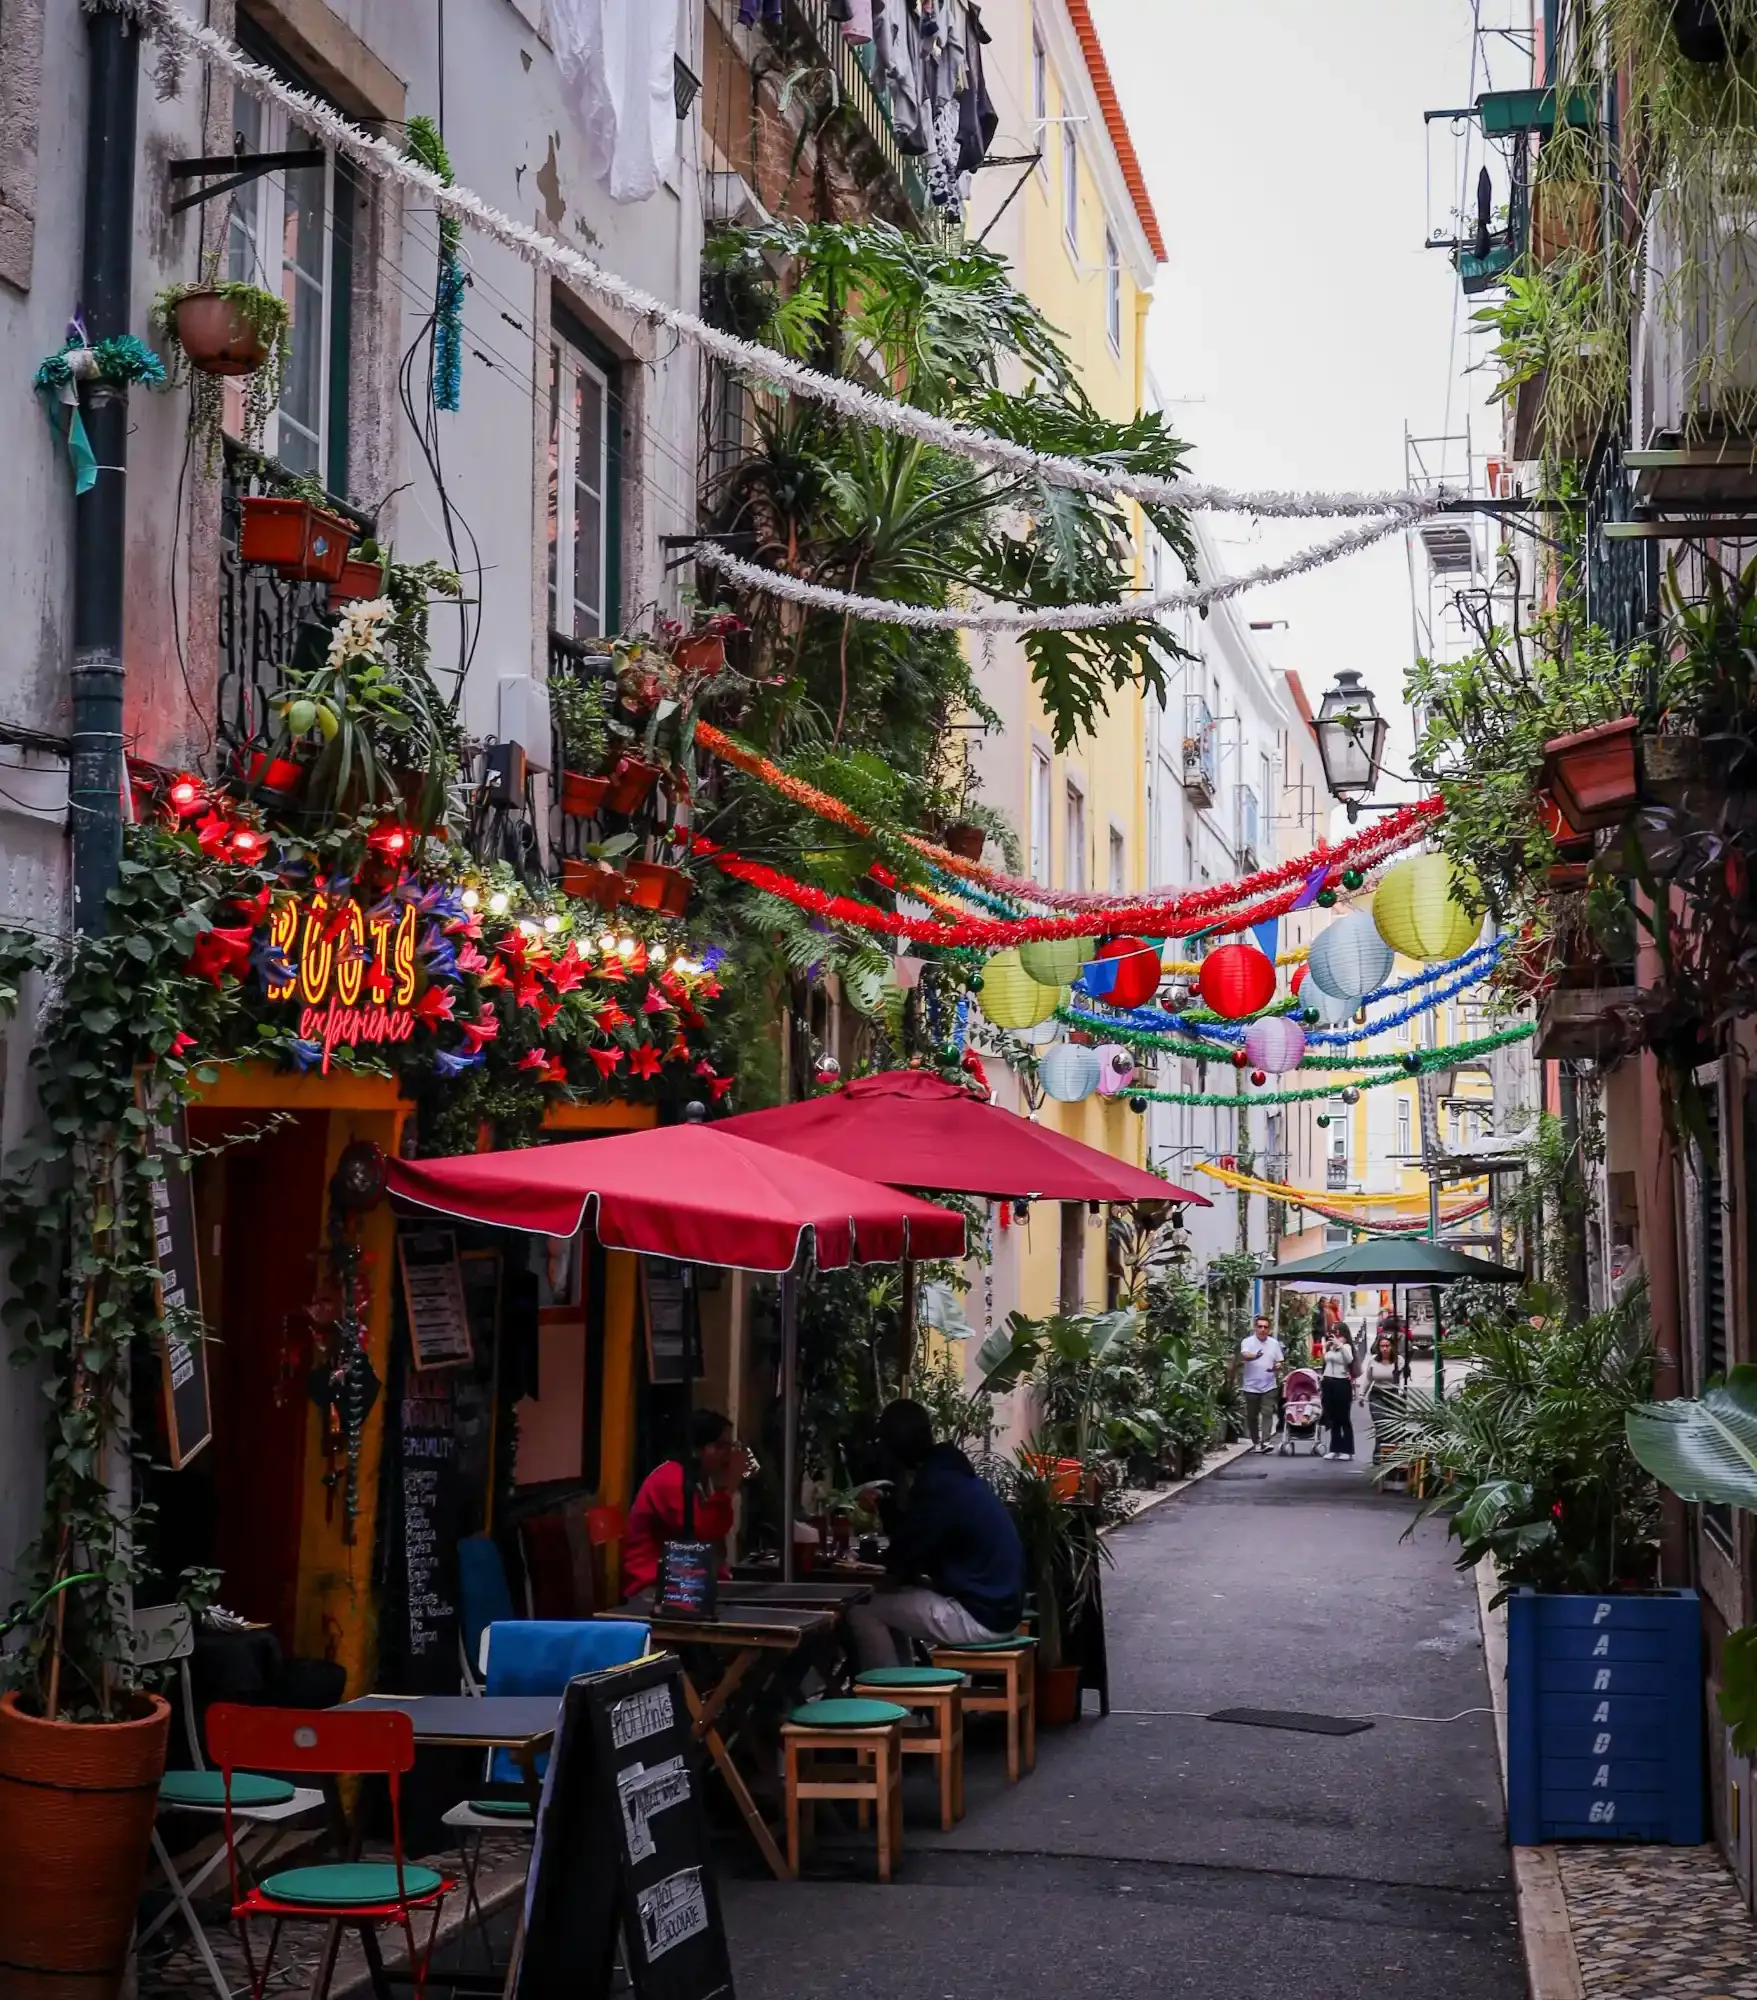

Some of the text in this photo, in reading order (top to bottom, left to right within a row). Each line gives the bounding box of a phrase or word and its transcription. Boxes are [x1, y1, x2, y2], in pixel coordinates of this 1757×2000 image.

[300, 996, 416, 1075] experience
[1588, 1603, 1616, 1823] PARADA 64
